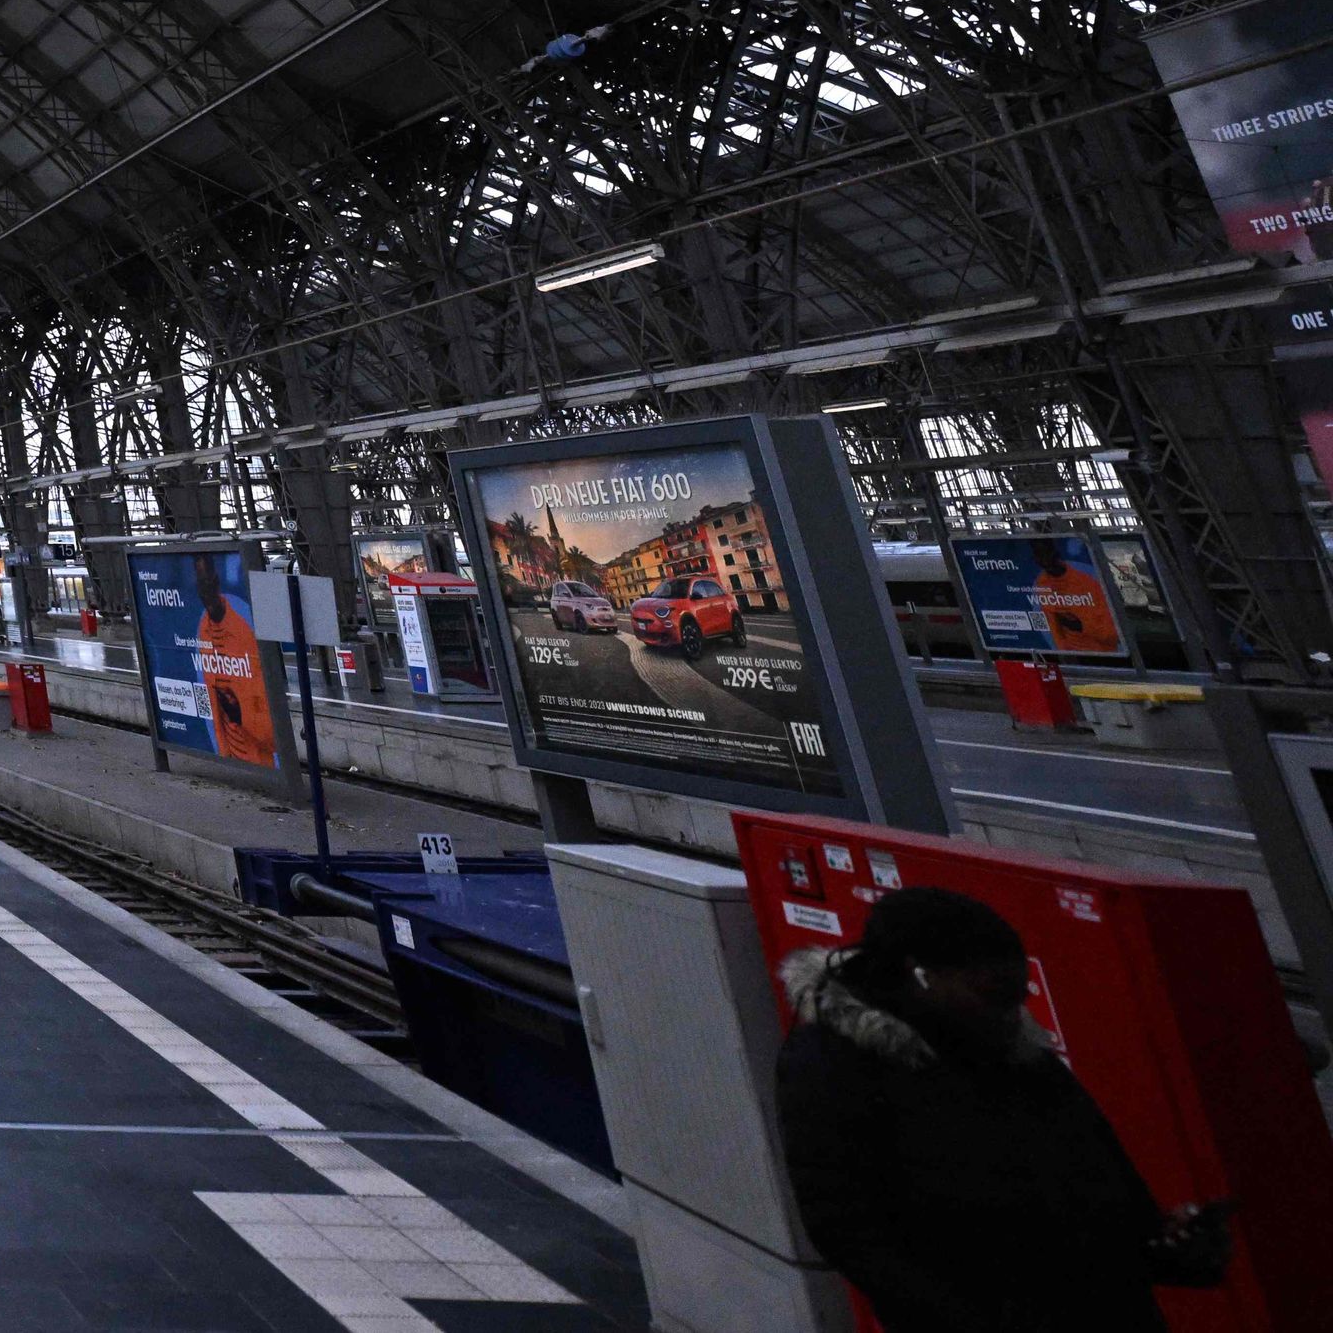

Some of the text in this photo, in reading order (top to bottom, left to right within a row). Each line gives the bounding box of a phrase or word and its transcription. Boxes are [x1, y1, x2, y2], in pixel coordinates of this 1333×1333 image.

[1212, 117, 1265, 143] THREE
[1250, 214, 1288, 236] TWO
[1291, 310, 1328, 332] ONE
[530, 472, 692, 509] DER NEUE FIAT 600
[562, 507, 669, 523] WILLKOMMEN IN DER FAMILIE
[60, 545, 74, 557] 15
[972, 557, 1019, 570] lernen.
[138, 571, 158, 581] Nicht nur
[145, 582, 185, 607] lernen.
[1006, 585, 1020, 593] Über
[1026, 592, 1096, 607] wachsen!
[174, 633, 186, 647] Über
[524, 636, 535, 645] FIAT
[536, 637, 547, 646] 500
[190, 649, 253, 679] wachsen!
[716, 655, 802, 670] NEUER FIAT 600 ELEKTRO
[538, 694, 706, 722] JETZT BIS ENDE 2023 UMWELTBONUS SICHERN
[790, 721, 826, 757] FIAT
[421, 836, 452, 855] 413
